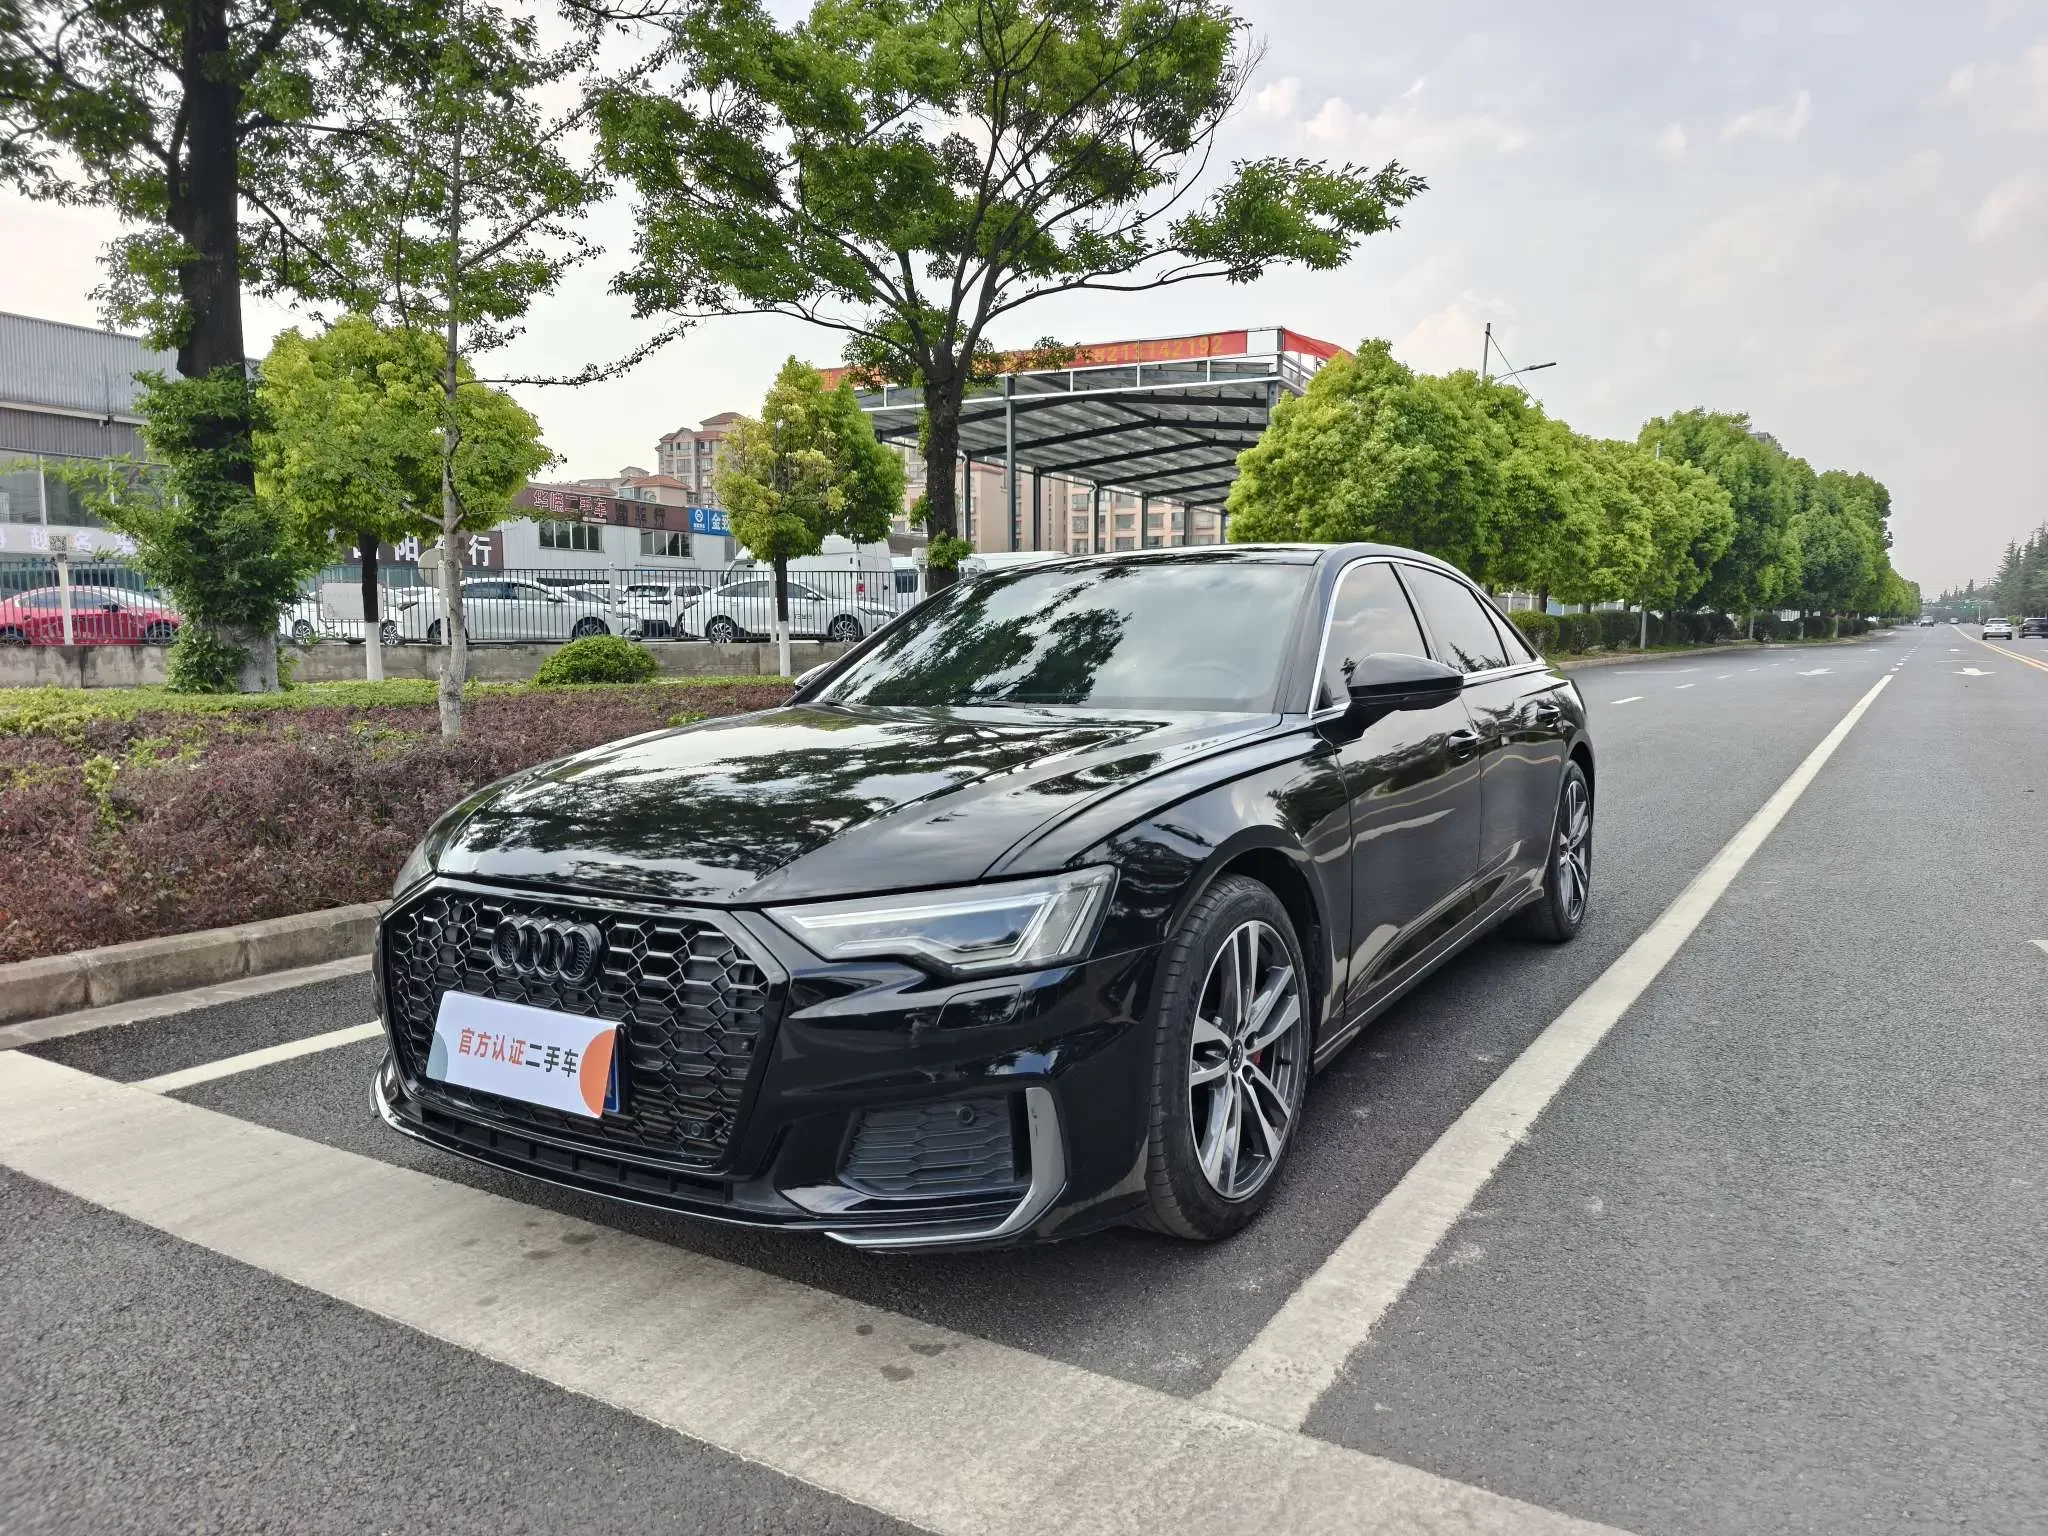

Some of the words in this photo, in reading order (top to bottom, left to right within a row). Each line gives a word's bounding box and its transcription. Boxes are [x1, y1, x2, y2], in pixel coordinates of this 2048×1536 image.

[458, 1027, 579, 1078] 官方认证二手车
